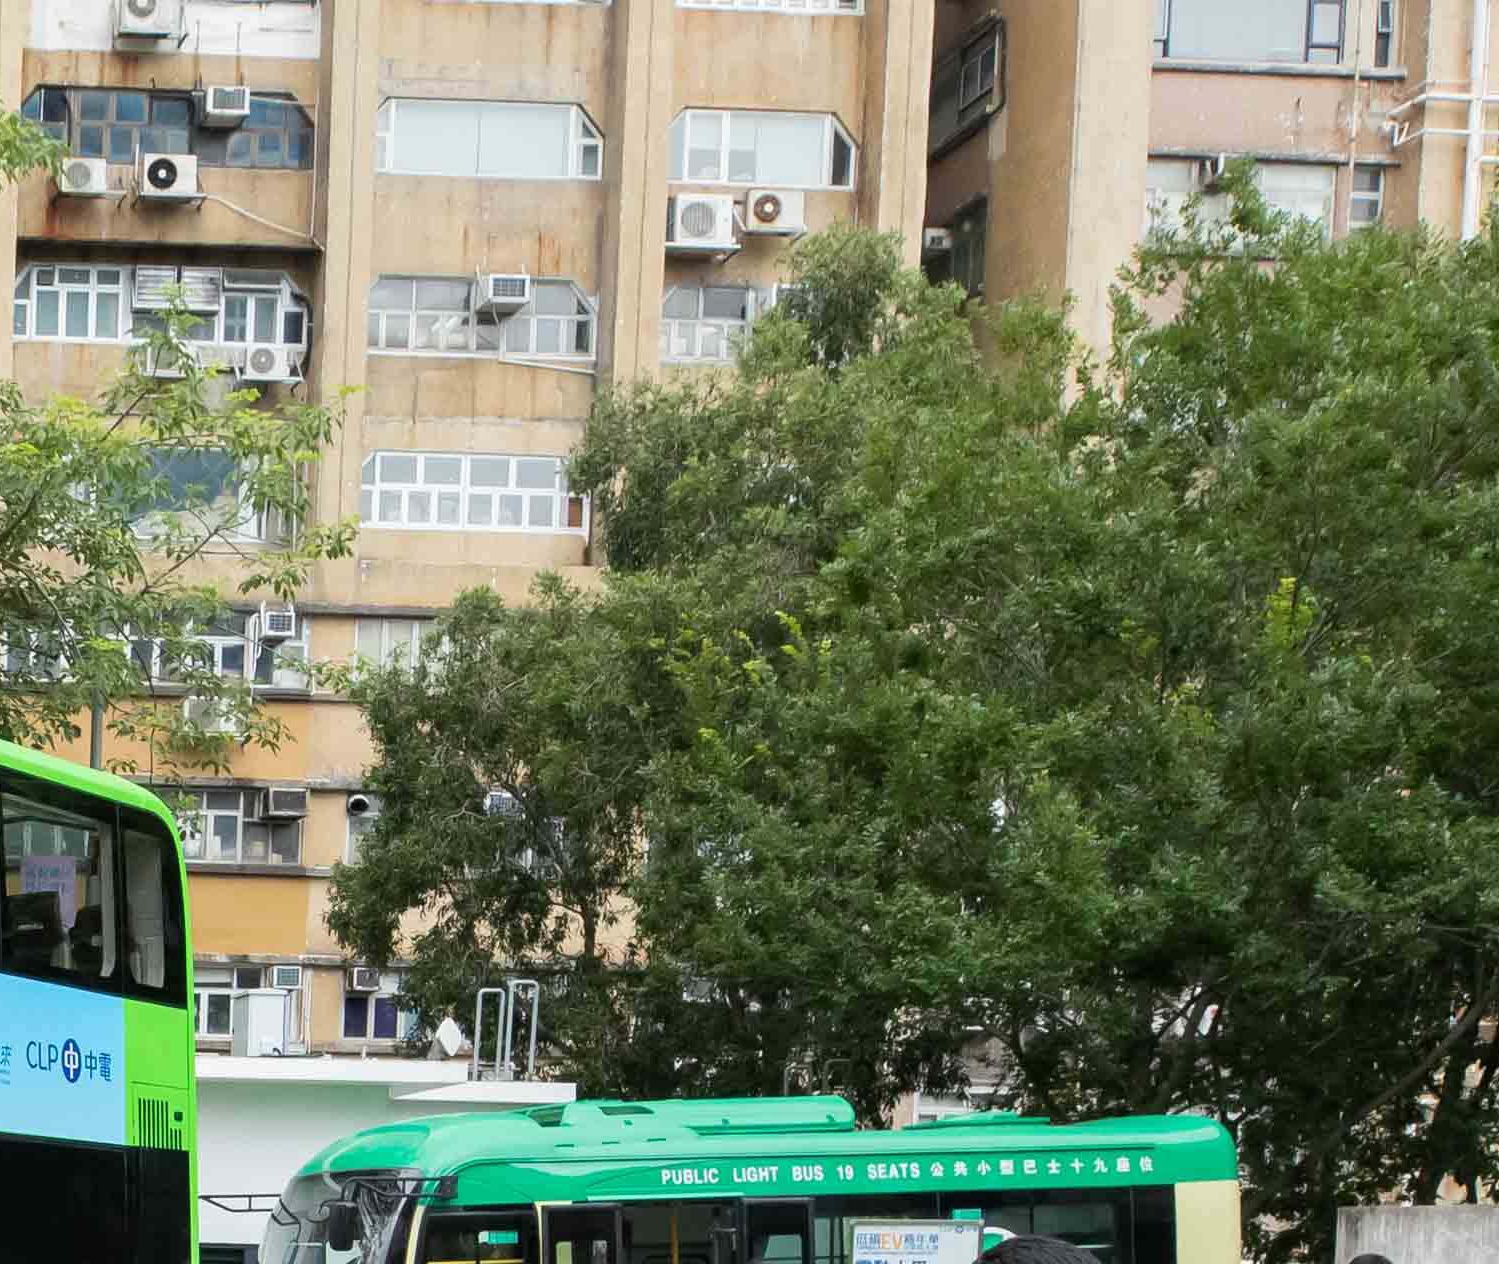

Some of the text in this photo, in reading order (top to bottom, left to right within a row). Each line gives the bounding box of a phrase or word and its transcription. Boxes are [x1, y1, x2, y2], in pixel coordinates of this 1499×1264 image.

[26, 1041, 113, 1082] CLP 中電
[661, 1168, 719, 1185] PUBLIC
[733, 1166, 778, 1183] LIGHT
[792, 1165, 824, 1182] BUS
[837, 1164, 854, 1180] 19
[867, 1163, 920, 1180] SEATS
